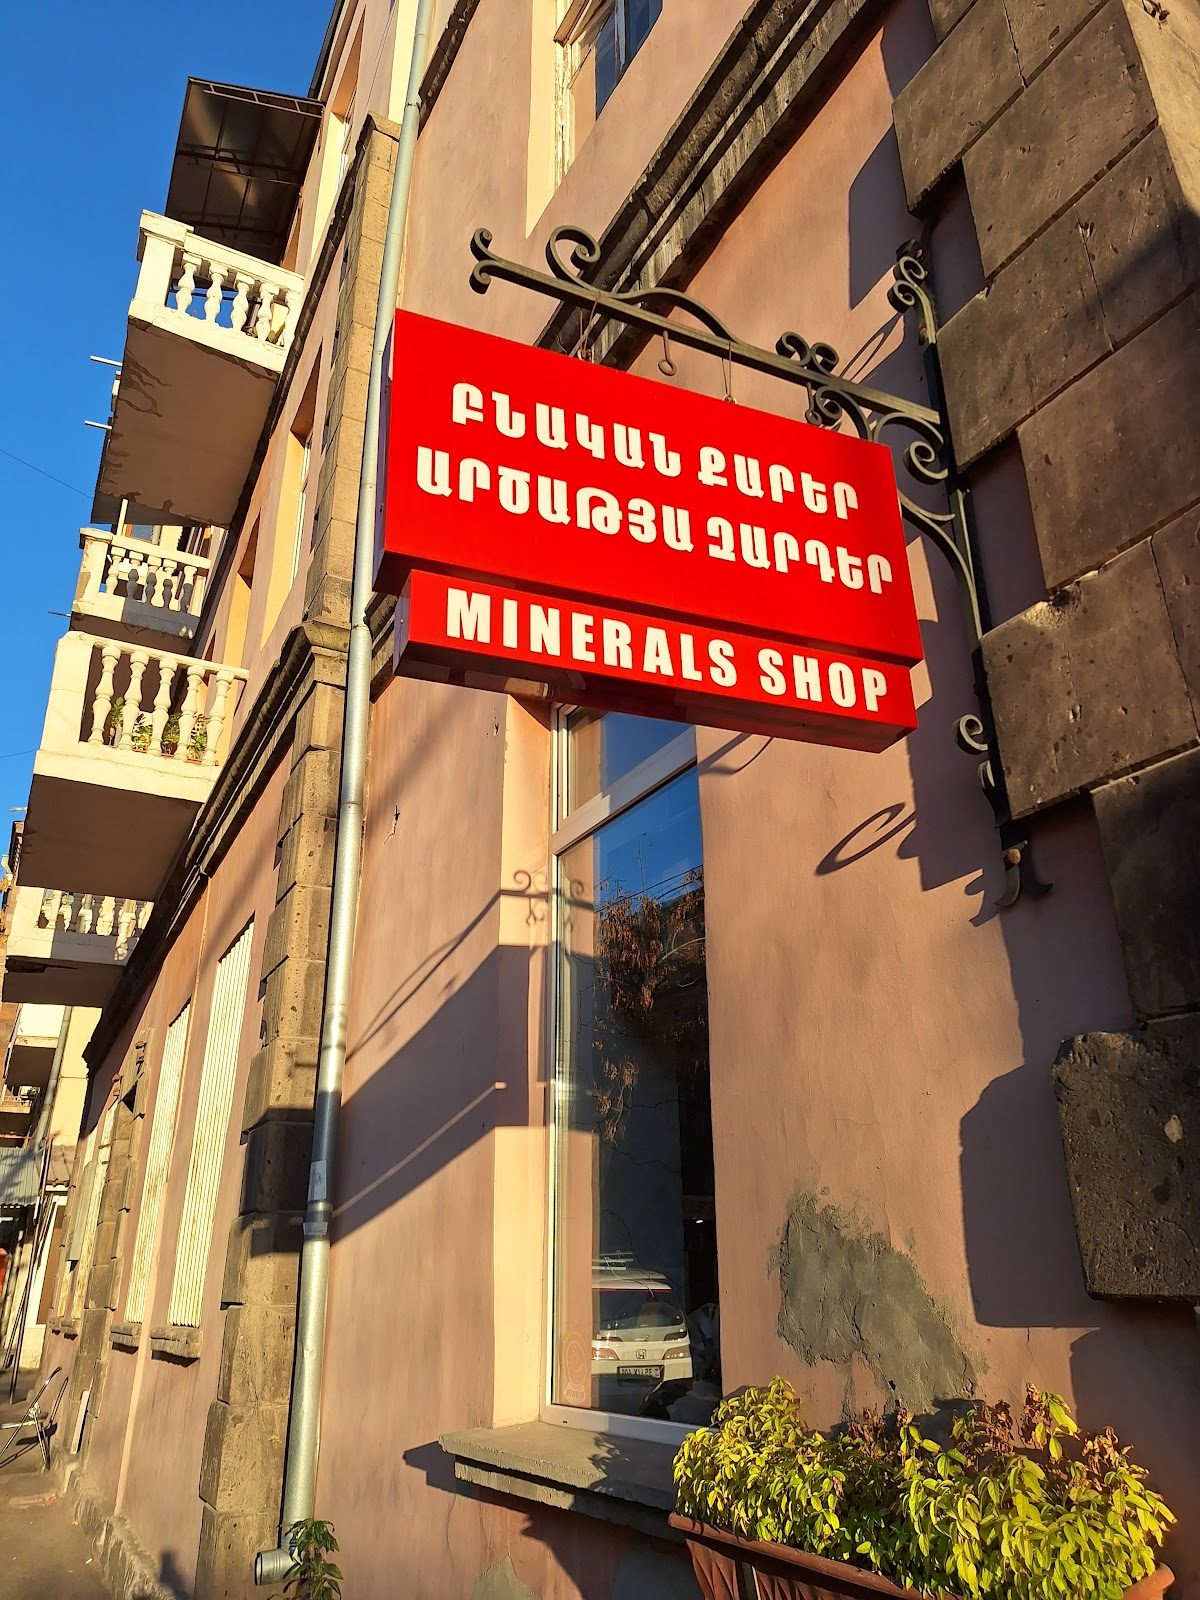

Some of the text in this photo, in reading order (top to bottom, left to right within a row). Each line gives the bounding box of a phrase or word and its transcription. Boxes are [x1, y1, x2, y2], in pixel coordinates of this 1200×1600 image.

[416, 445, 893, 594] ԱՐԾԱԹՅԱ ԶԱՐԴԵՐ
[452, 382, 859, 520] ԲՆԱԿԱՆ ՔԱՐԵՐ
[446, 587, 887, 712] MINERALS SHOP
